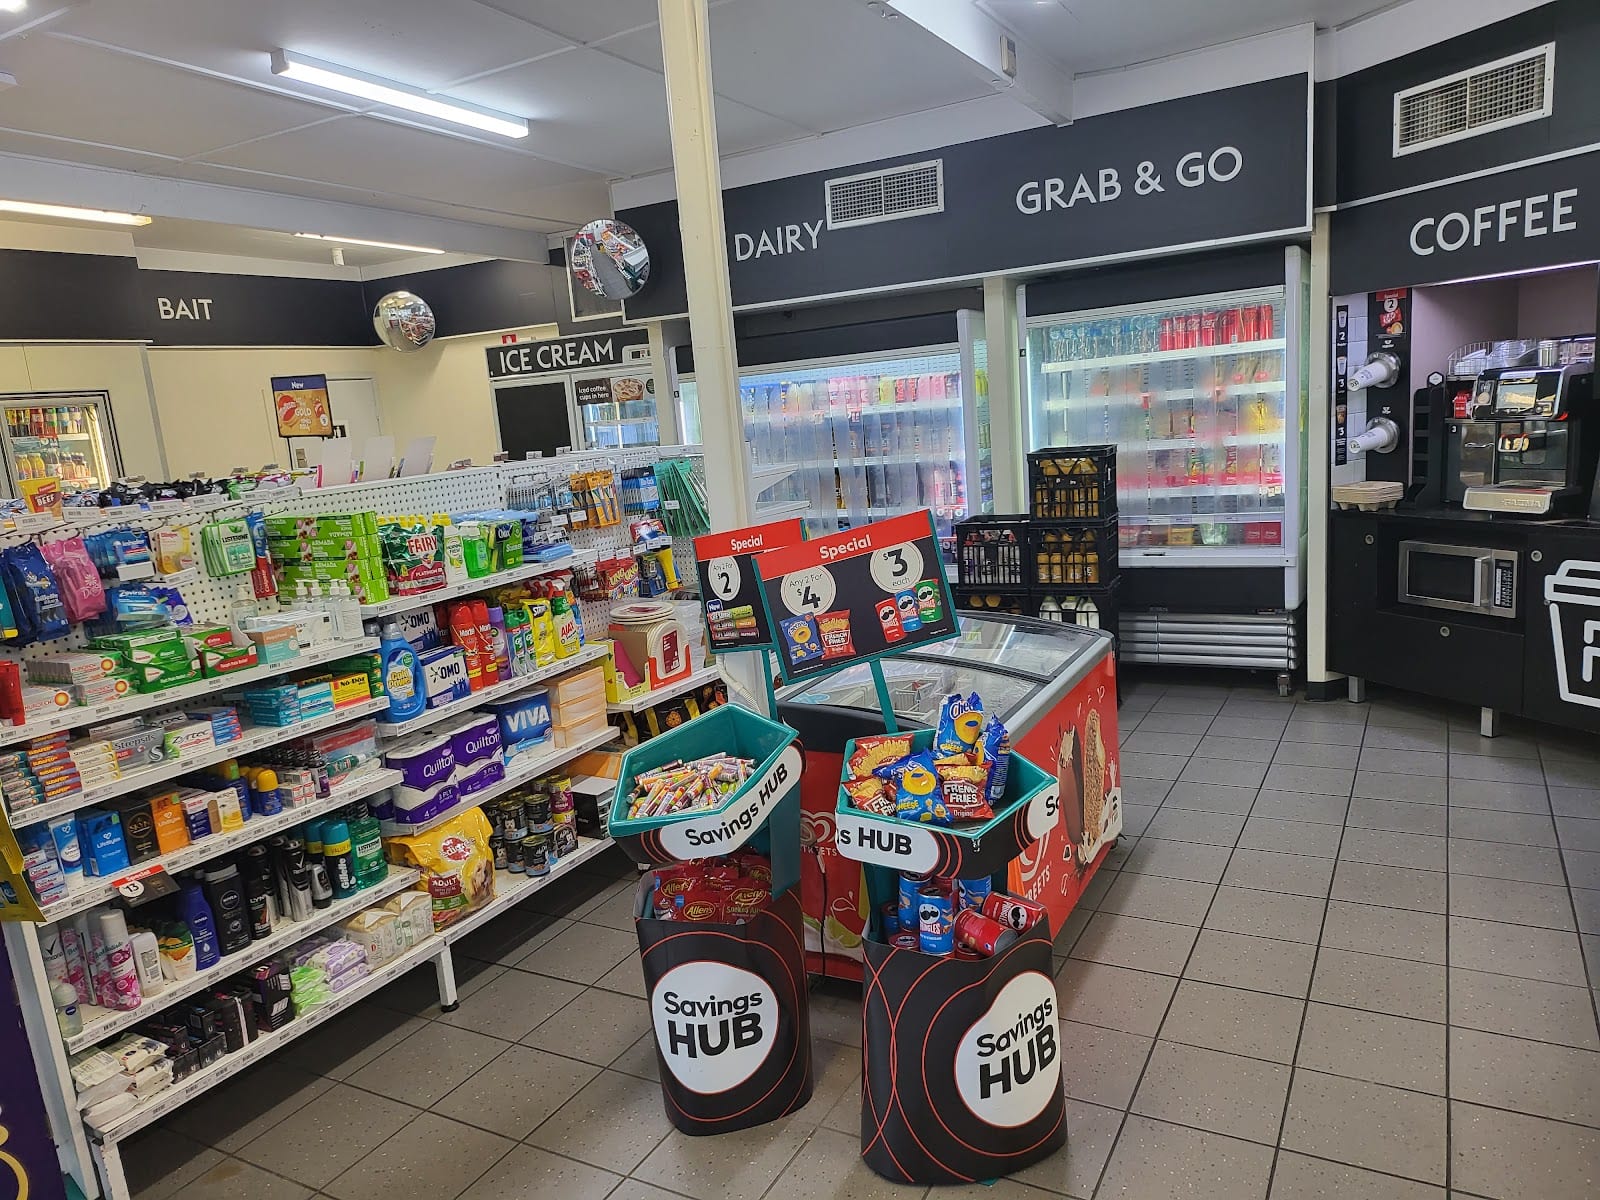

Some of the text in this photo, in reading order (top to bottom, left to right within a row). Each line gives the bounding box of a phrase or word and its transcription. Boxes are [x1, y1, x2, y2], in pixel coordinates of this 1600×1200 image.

[1016, 145, 1244, 216] GRAB & GO
[1409, 187, 1578, 256] COFFEE
[734, 219, 824, 263] DAIRY
[157, 297, 213, 321] BAIT
[1338, 331, 1346, 341] 2
[500, 337, 615, 374] ICE CREAM
[1339, 379, 1345, 388] 3
[295, 407, 312, 417] GOLD
[1339, 427, 1345, 436] 3
[37, 494, 55, 507] BEEF
[407, 535, 438, 554] FAIRY
[731, 535, 764, 553] Special
[819, 534, 873, 560] Special
[883, 548, 909, 578] $3
[717, 571, 732, 594] $2
[789, 579, 803, 588] Any
[811, 573, 823, 581] For
[891, 576, 911, 588] each
[796, 585, 821, 609] $4
[410, 612, 430, 628] OMO
[390, 669, 410, 680] Cold
[440, 662, 461, 680] OMO
[505, 704, 550, 733] VIVA
[114, 733, 156, 750] Strepsils
[465, 732, 501, 754] Quilton
[423, 752, 455, 778] Quilton
[488, 764, 498, 774] PLY
[443, 789, 452, 798] PLY
[949, 793, 977, 804] FRIES
[424, 810, 430, 818] 4
[684, 763, 788, 847] Savings HUB
[953, 808, 974, 818] Original
[858, 826, 912, 856] HUB
[340, 857, 350, 889] Gillette
[686, 906, 714, 916] Allen's
[663, 990, 763, 1017] Savings
[667, 1012, 763, 1060] HUB
[976, 996, 1053, 1058] Savings
[979, 1023, 1057, 1100] HUB
